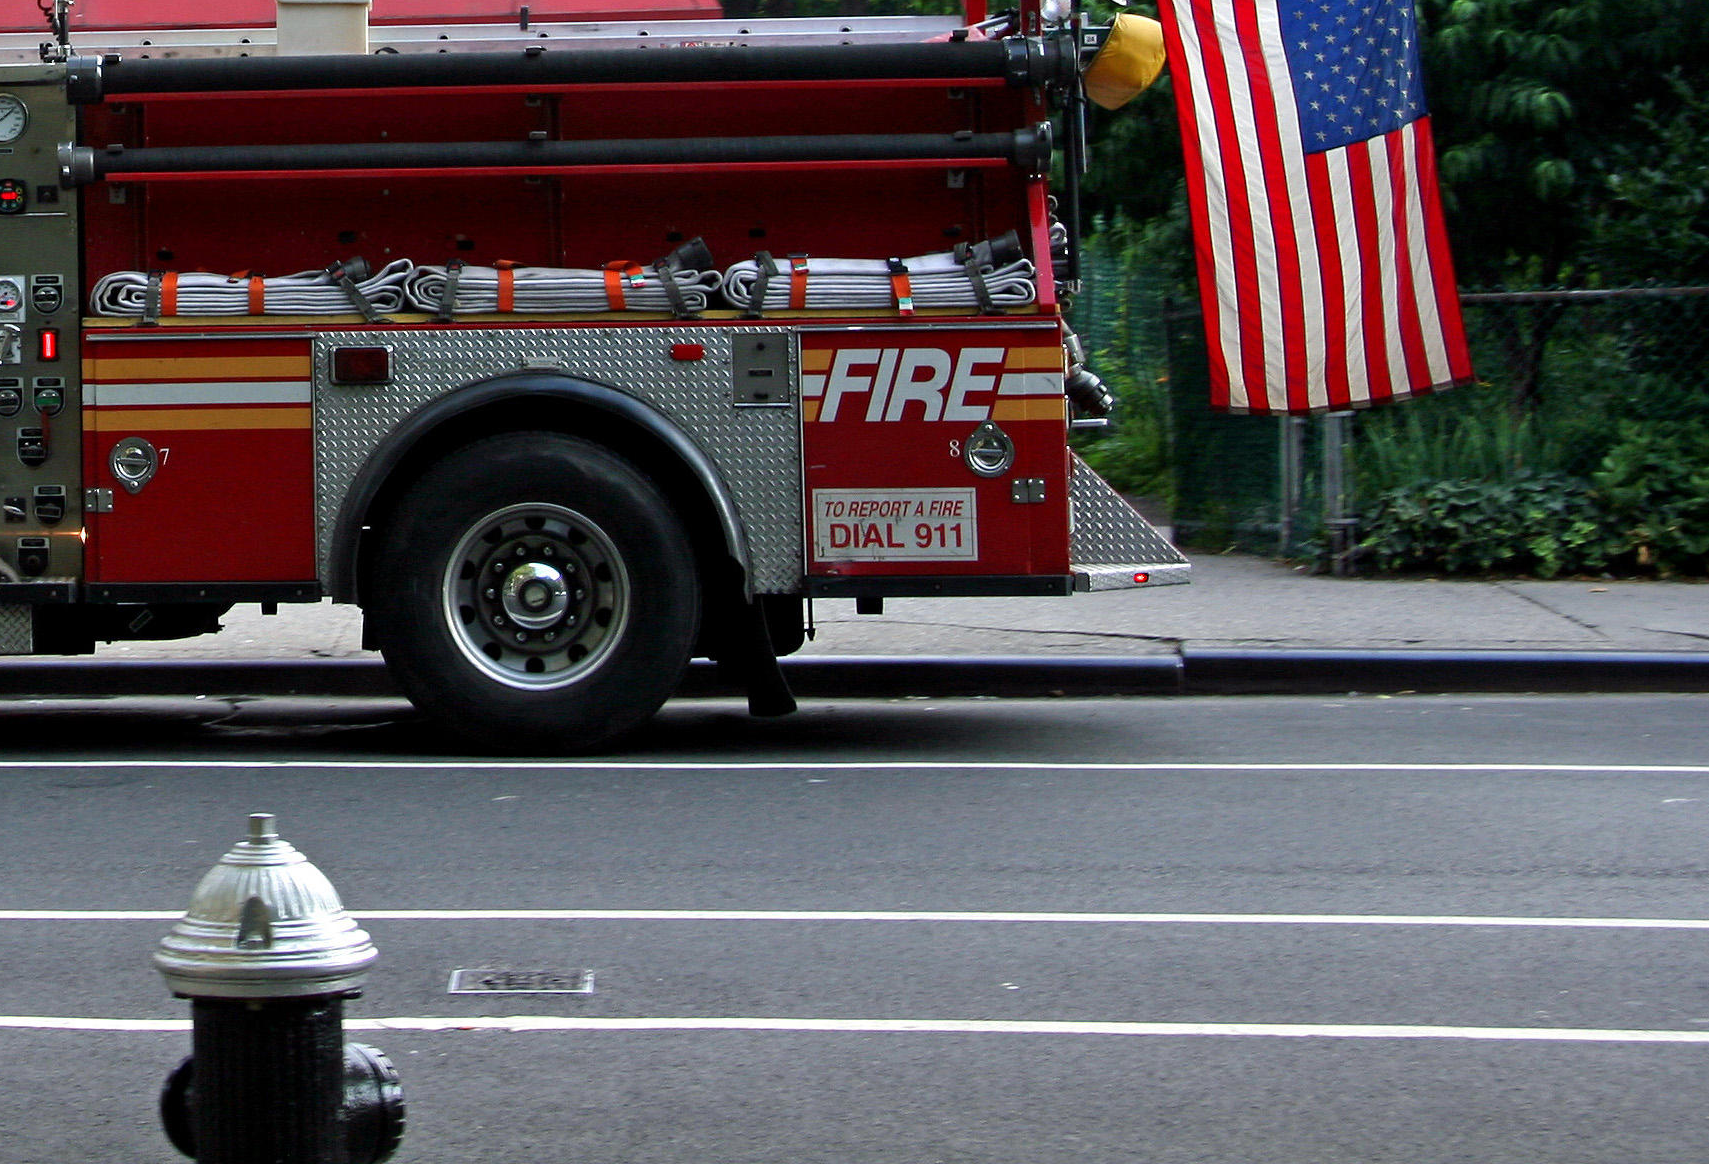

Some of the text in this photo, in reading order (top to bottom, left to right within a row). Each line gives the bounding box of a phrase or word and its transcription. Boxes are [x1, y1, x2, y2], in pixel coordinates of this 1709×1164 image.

[819, 347, 1005, 422] FIRE
[159, 448, 170, 465] 7
[949, 439, 960, 457] 8
[825, 500, 964, 518] TO REPORT A FIRE
[829, 522, 963, 549] DIAL 911
